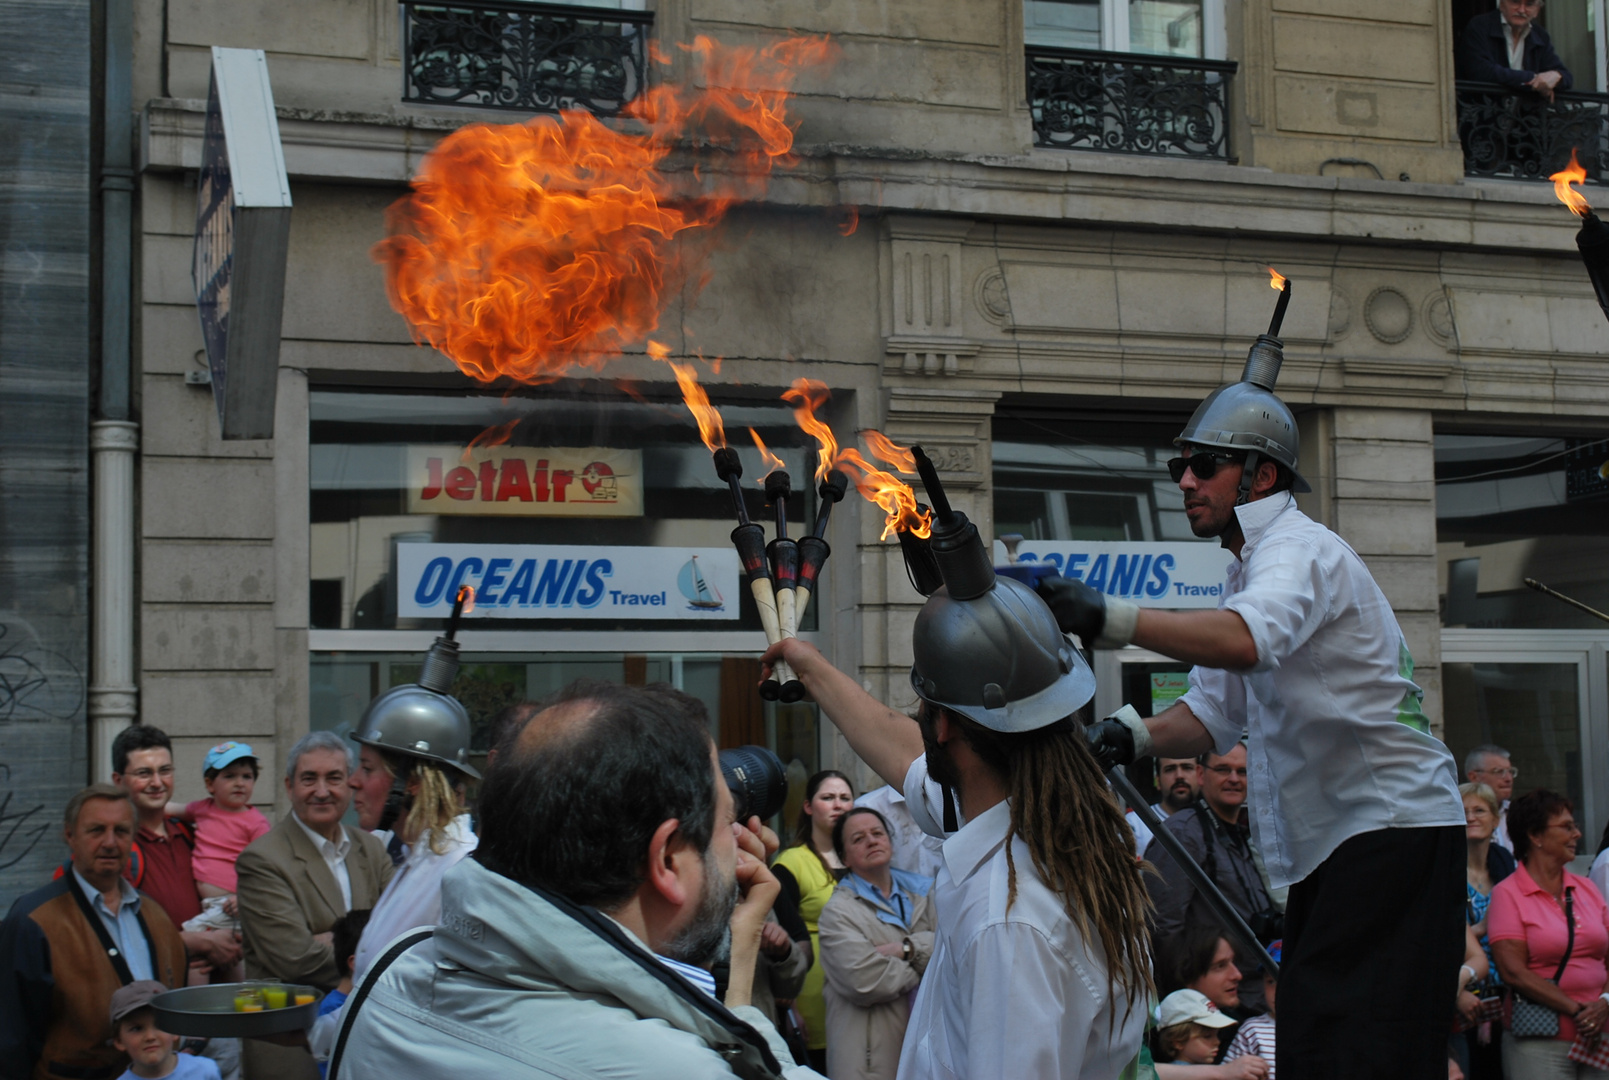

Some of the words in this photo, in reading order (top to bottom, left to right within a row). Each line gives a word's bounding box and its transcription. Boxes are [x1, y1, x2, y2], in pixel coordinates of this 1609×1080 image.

[421, 458, 573, 503] JetAir
[414, 556, 614, 608] OCEANIS
[611, 591, 667, 606] Travel
[1017, 552, 1175, 599] EANIS
[1174, 582, 1222, 596] Travel
